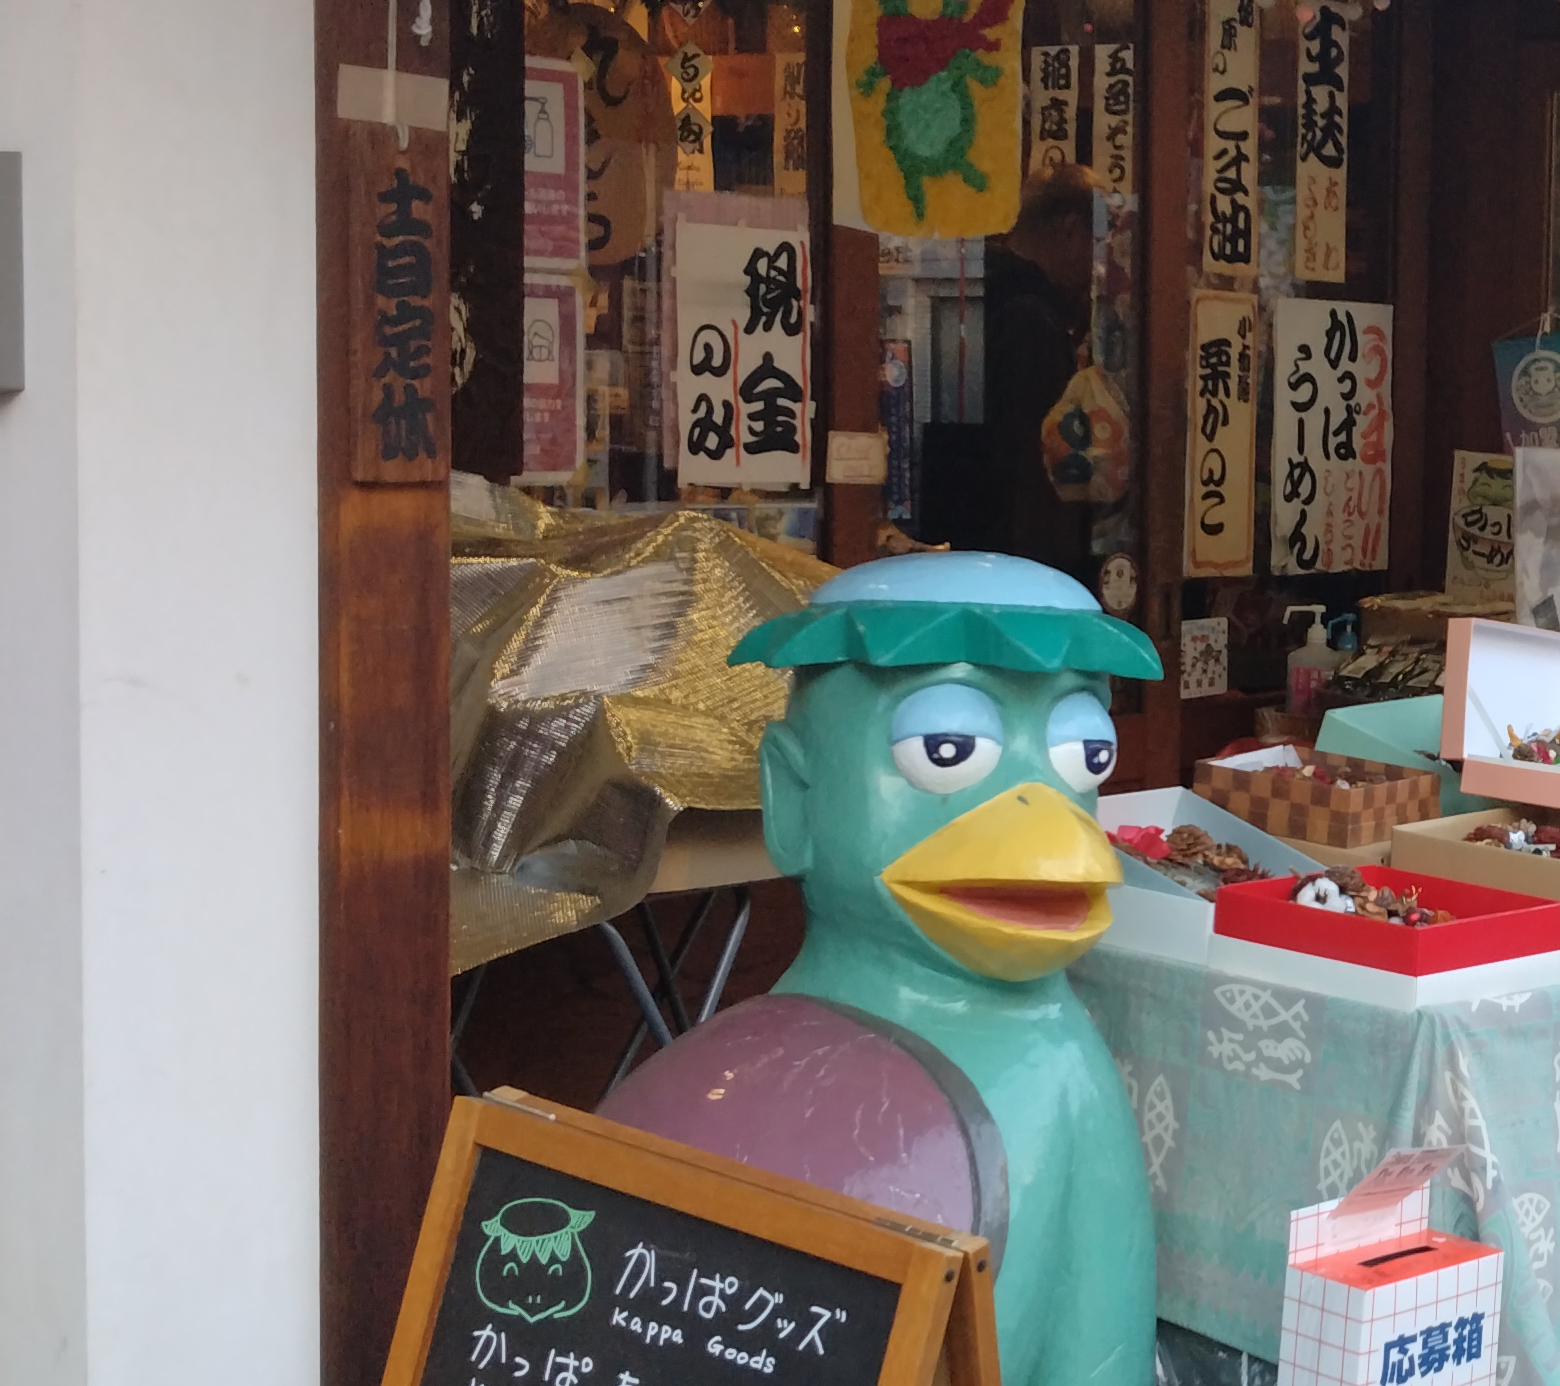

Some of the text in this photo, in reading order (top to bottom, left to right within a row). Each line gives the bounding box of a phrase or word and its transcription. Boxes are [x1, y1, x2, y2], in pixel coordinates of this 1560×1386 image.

[1104, 44, 1135, 193] 五色そう
[373, 166, 437, 462] 土日定休
[739, 240, 804, 457] 現金
[1322, 307, 1363, 462] かっぱ
[687, 322, 734, 461] のみ
[1199, 337, 1233, 537] 栗かのこ
[612, 1240, 848, 1357] かっぱグッズ
[612, 1307, 777, 1375] Kappa Goods
